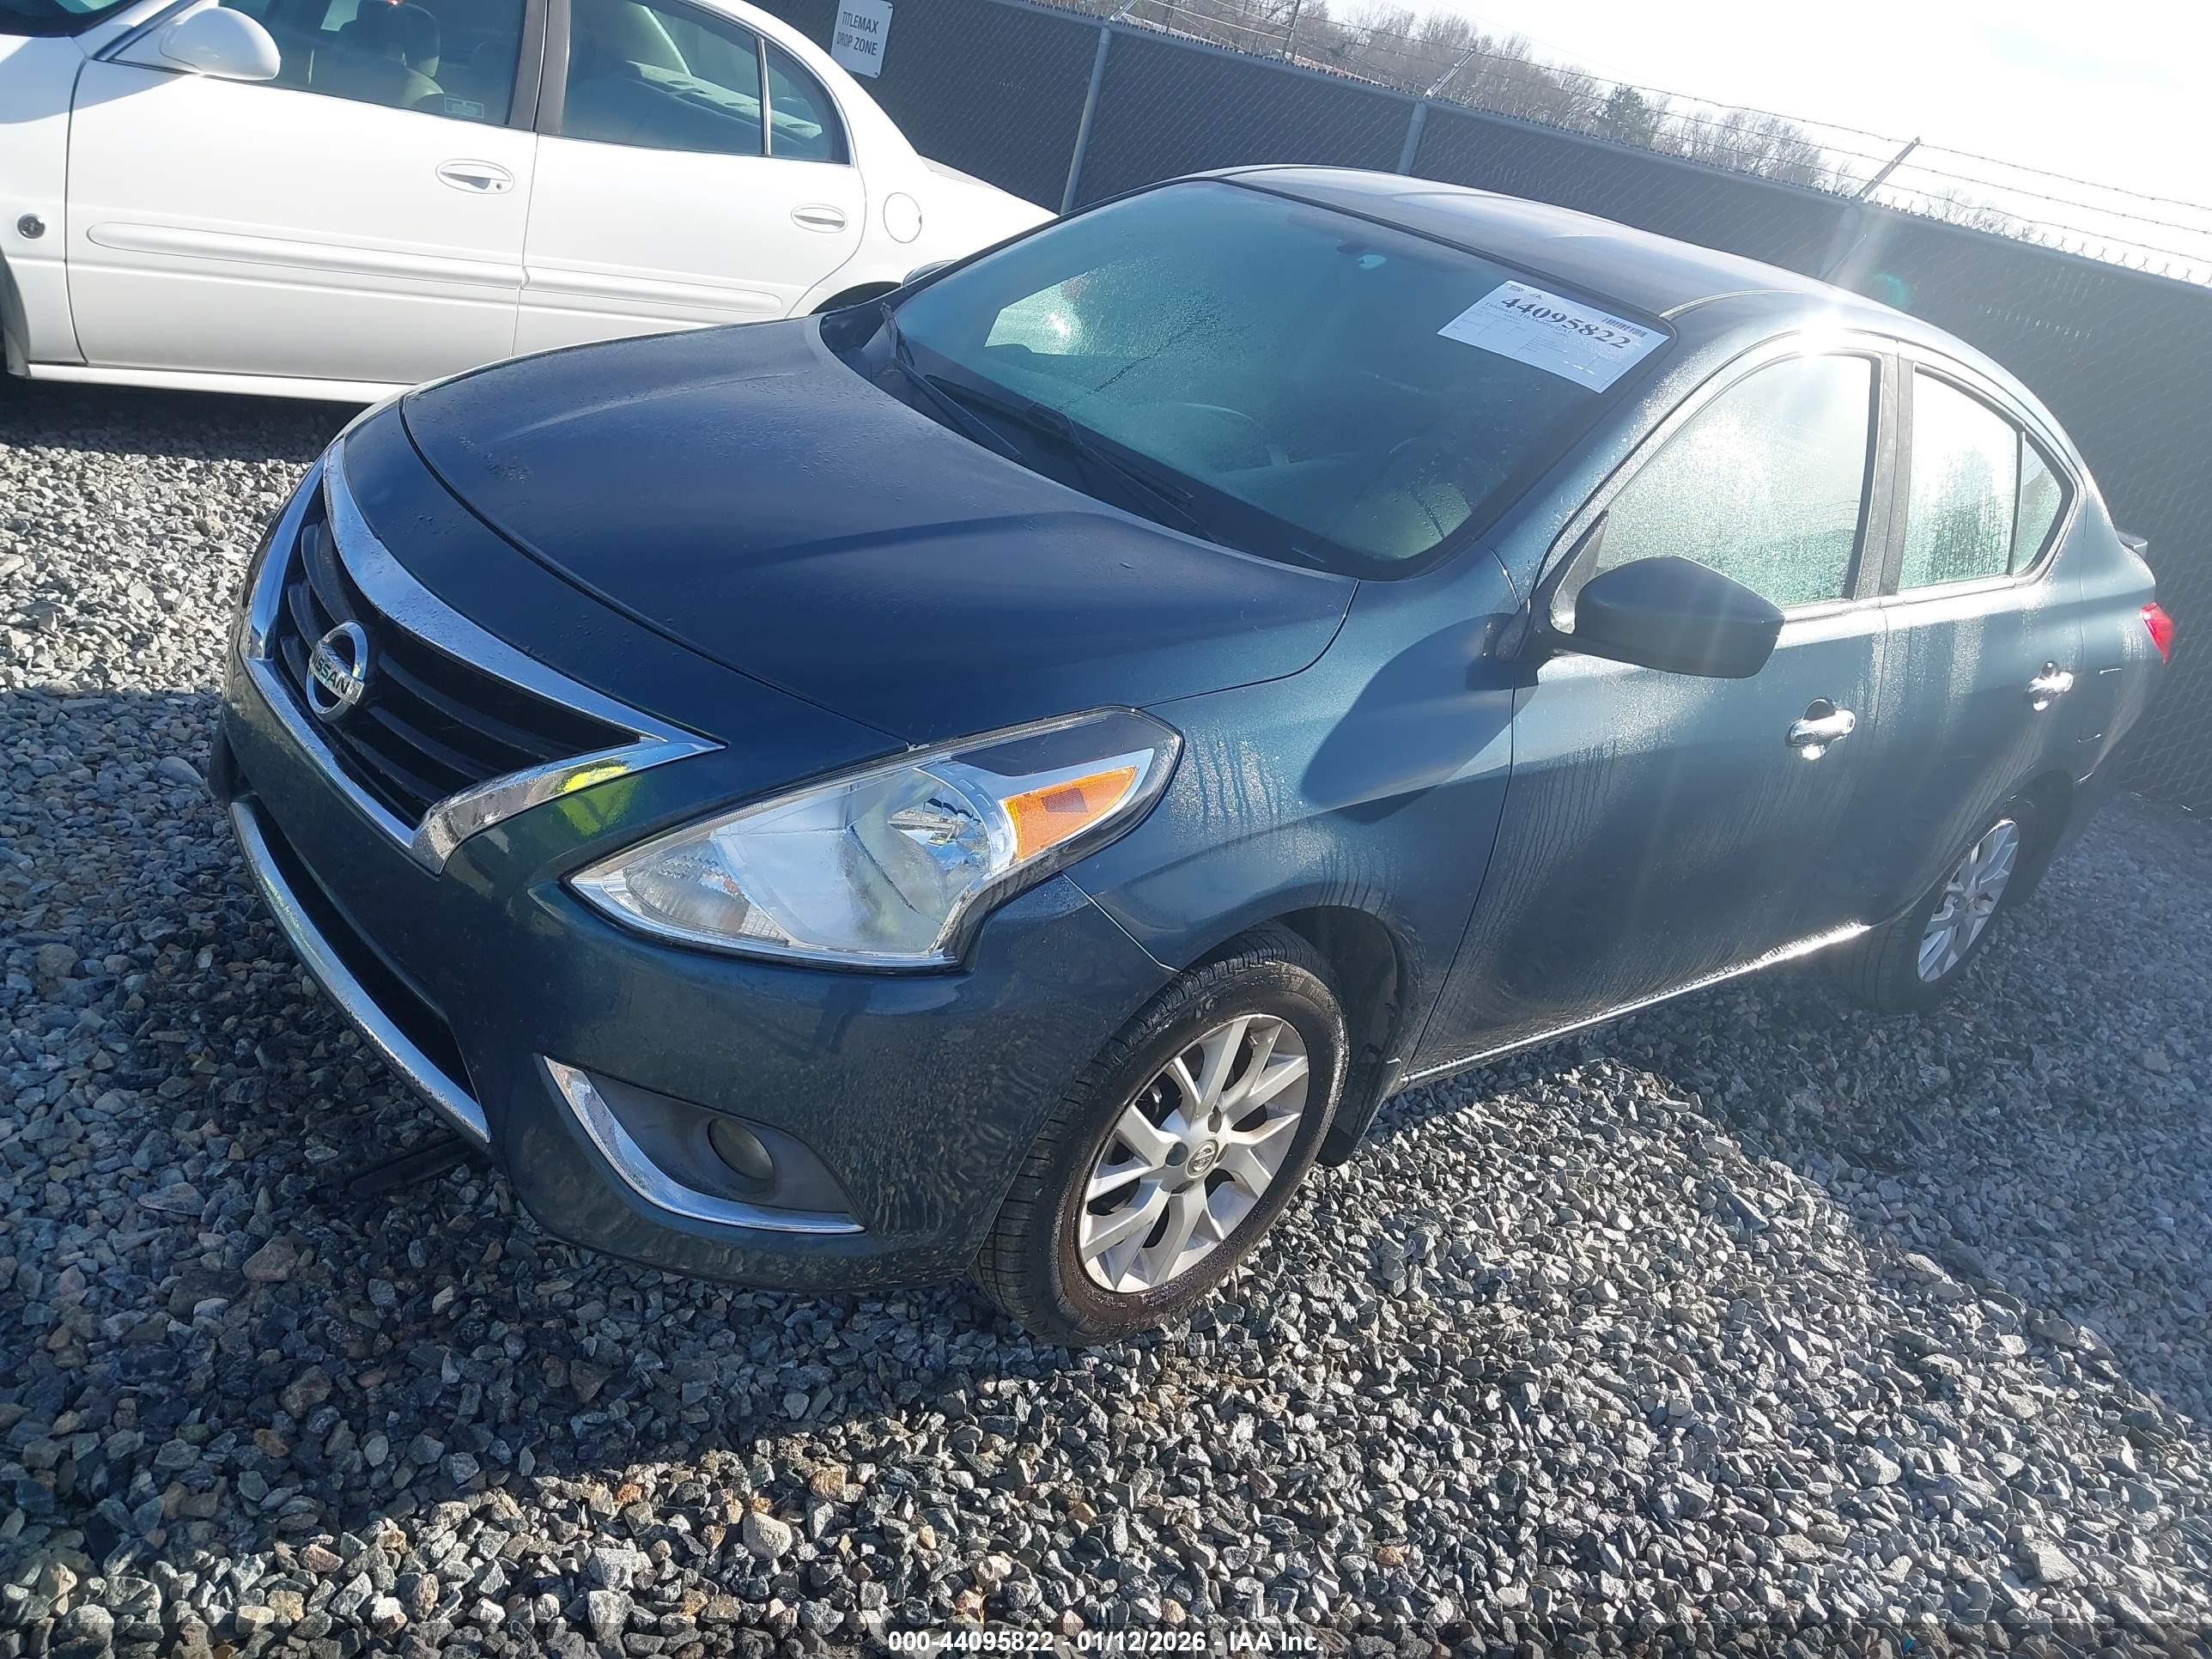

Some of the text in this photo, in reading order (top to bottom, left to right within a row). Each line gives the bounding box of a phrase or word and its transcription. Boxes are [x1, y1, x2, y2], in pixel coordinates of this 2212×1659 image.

[842, 11, 879, 34] TITLEMAX
[836, 32, 878, 56] DROP ZONE
[1501, 297, 1632, 349] 44095822
